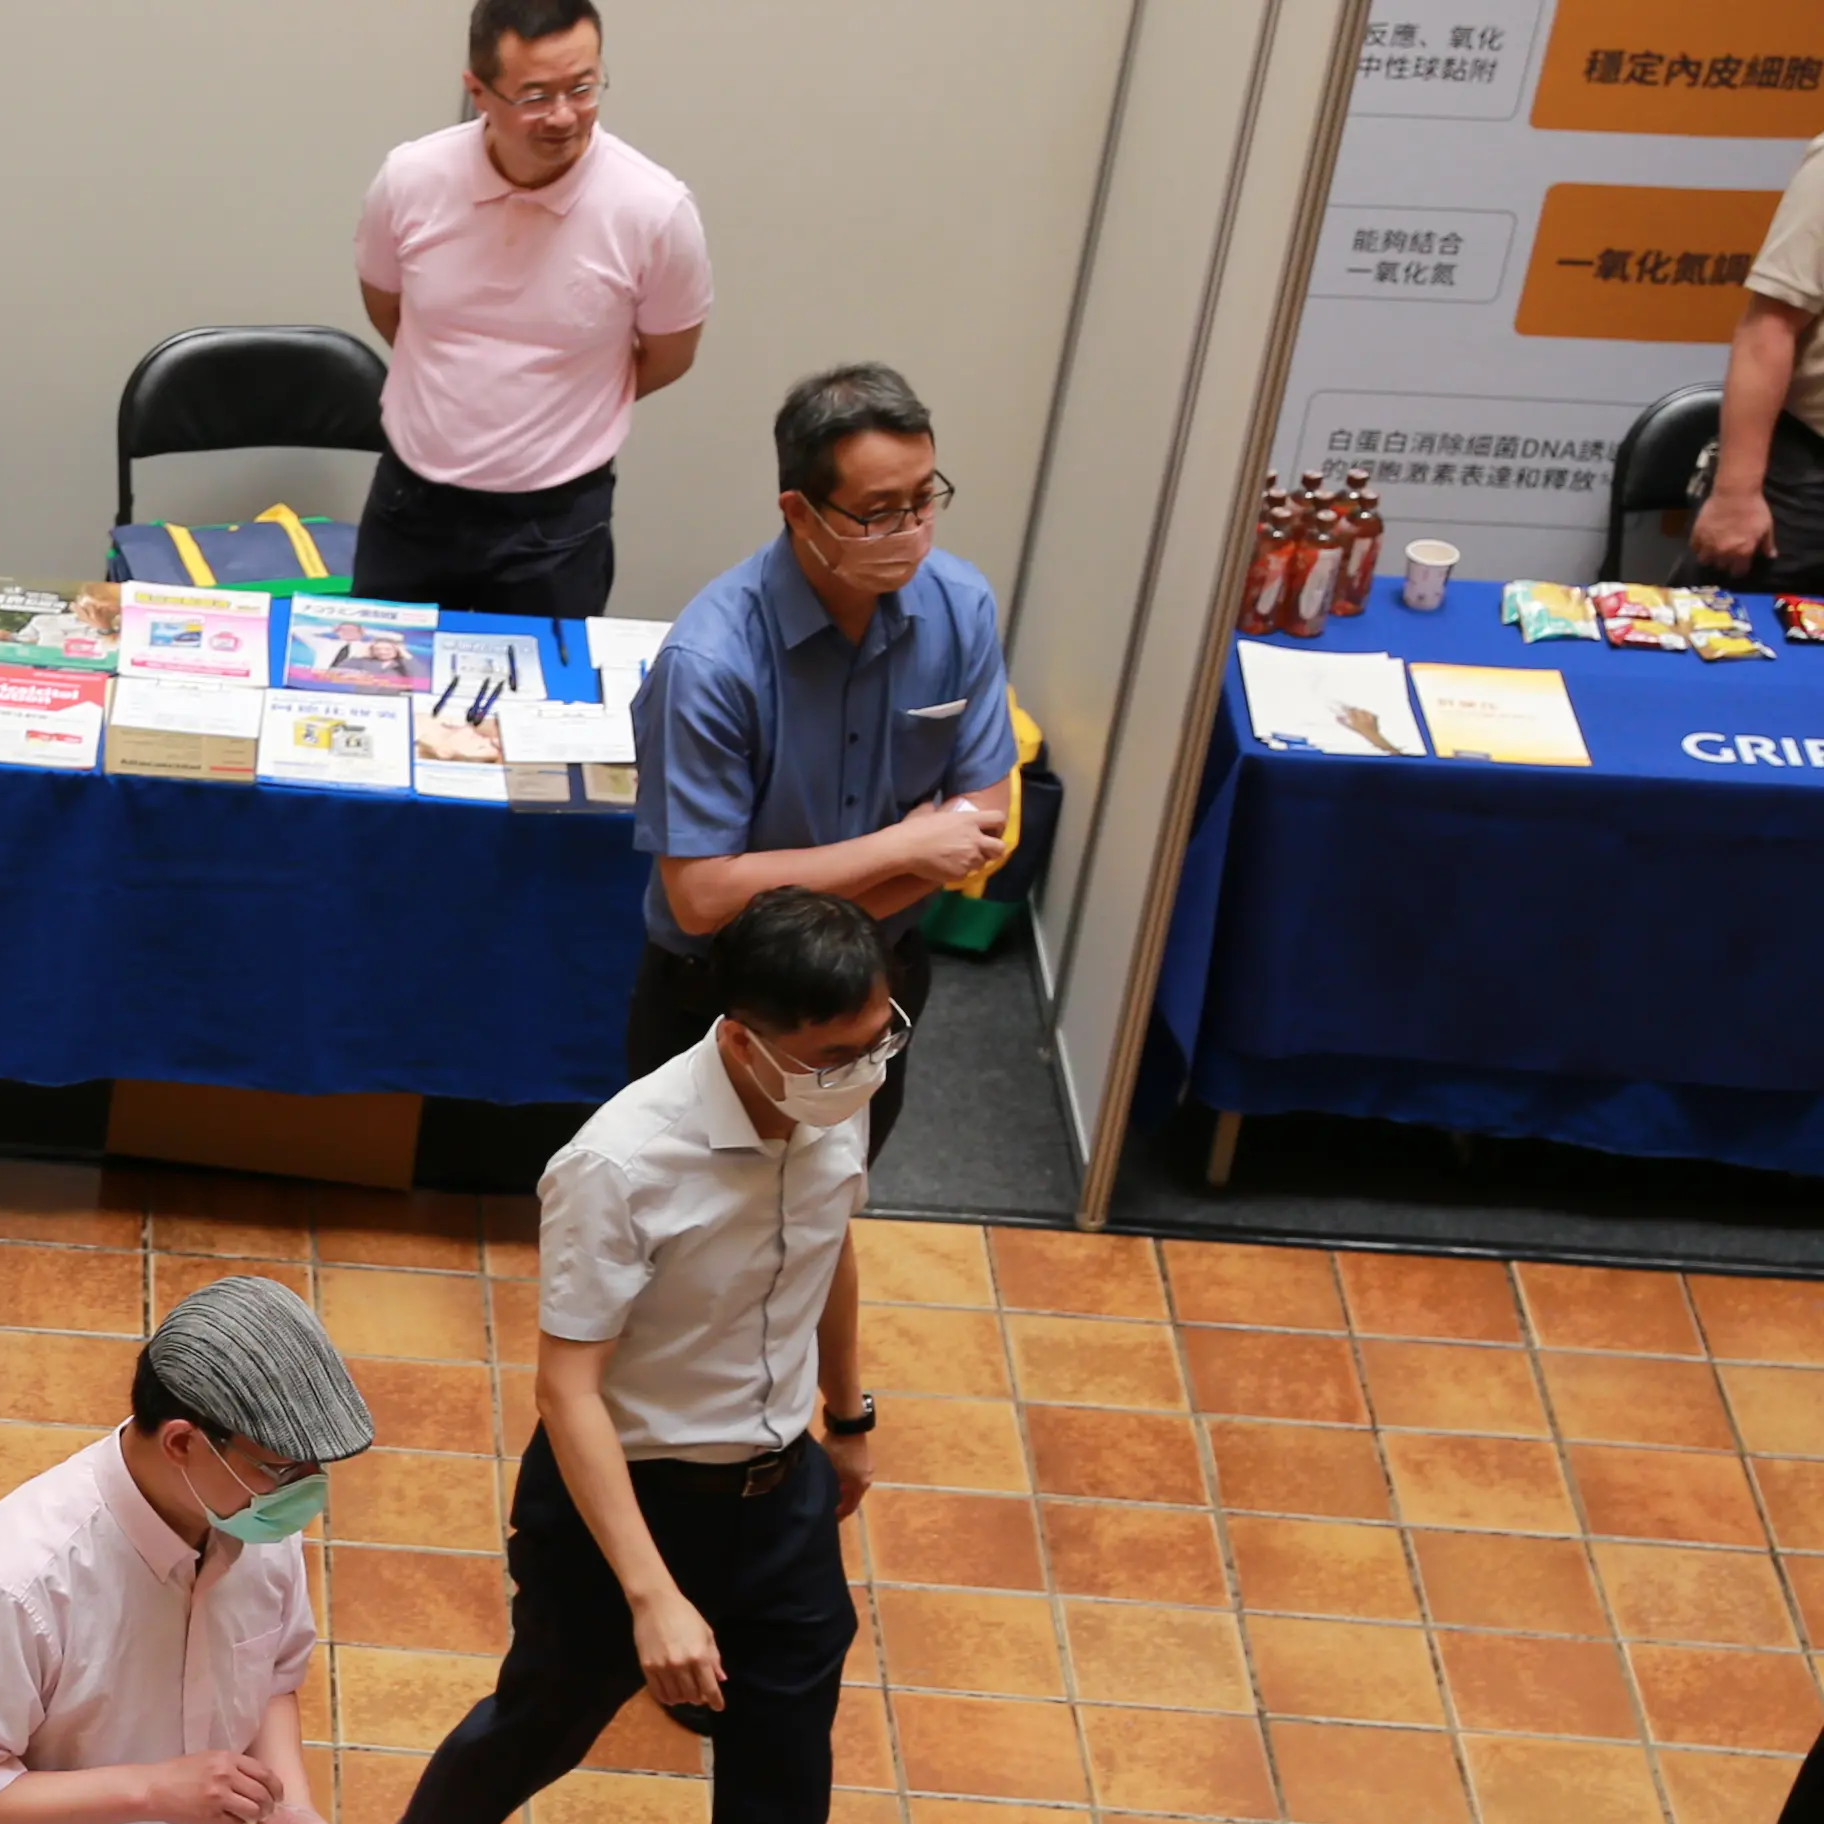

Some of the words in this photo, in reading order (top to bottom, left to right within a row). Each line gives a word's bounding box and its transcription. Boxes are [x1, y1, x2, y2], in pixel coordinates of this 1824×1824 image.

[1353, 229, 1464, 256] 能夠結合
[1346, 260, 1458, 286] 一氧化氮
